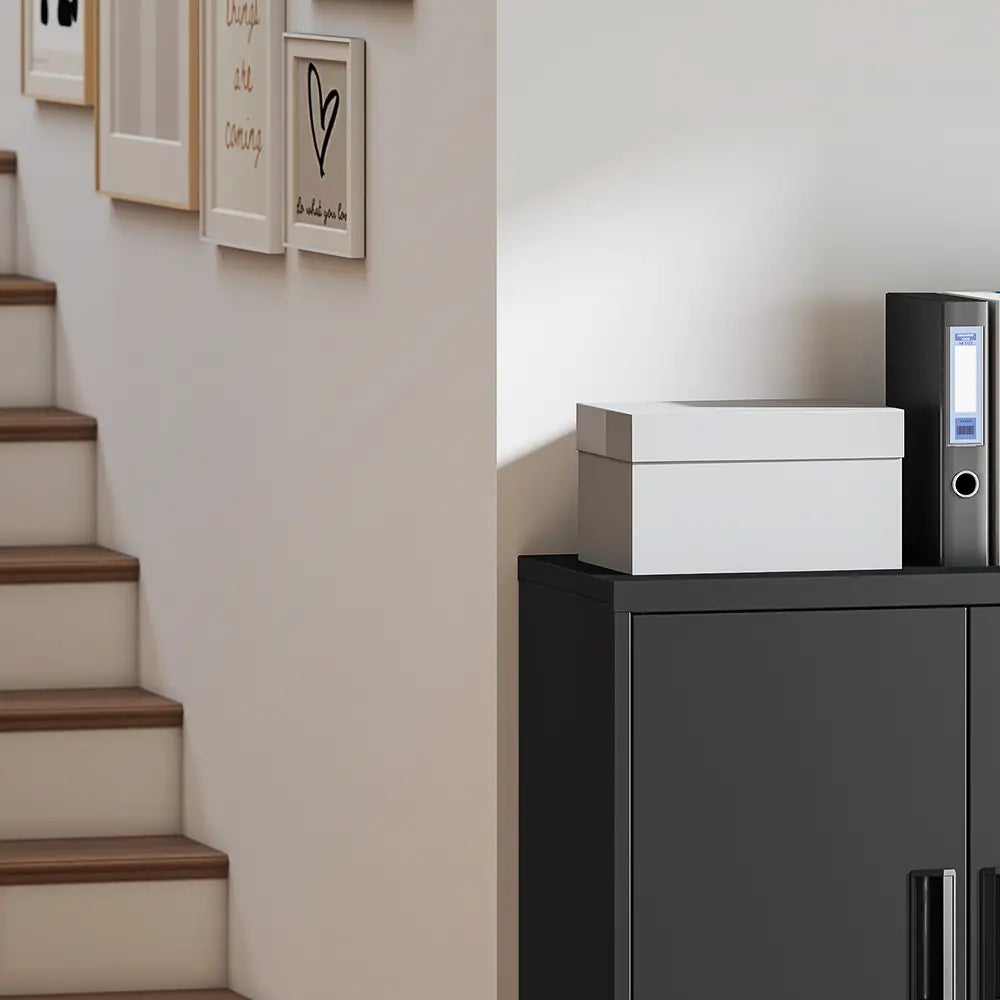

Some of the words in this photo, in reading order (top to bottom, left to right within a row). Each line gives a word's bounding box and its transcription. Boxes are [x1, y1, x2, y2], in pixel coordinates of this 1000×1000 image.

[233, 59, 254, 92] are
[225, 117, 262, 168] coming
[305, 198, 322, 217] what
[323, 208, 337, 225] you
